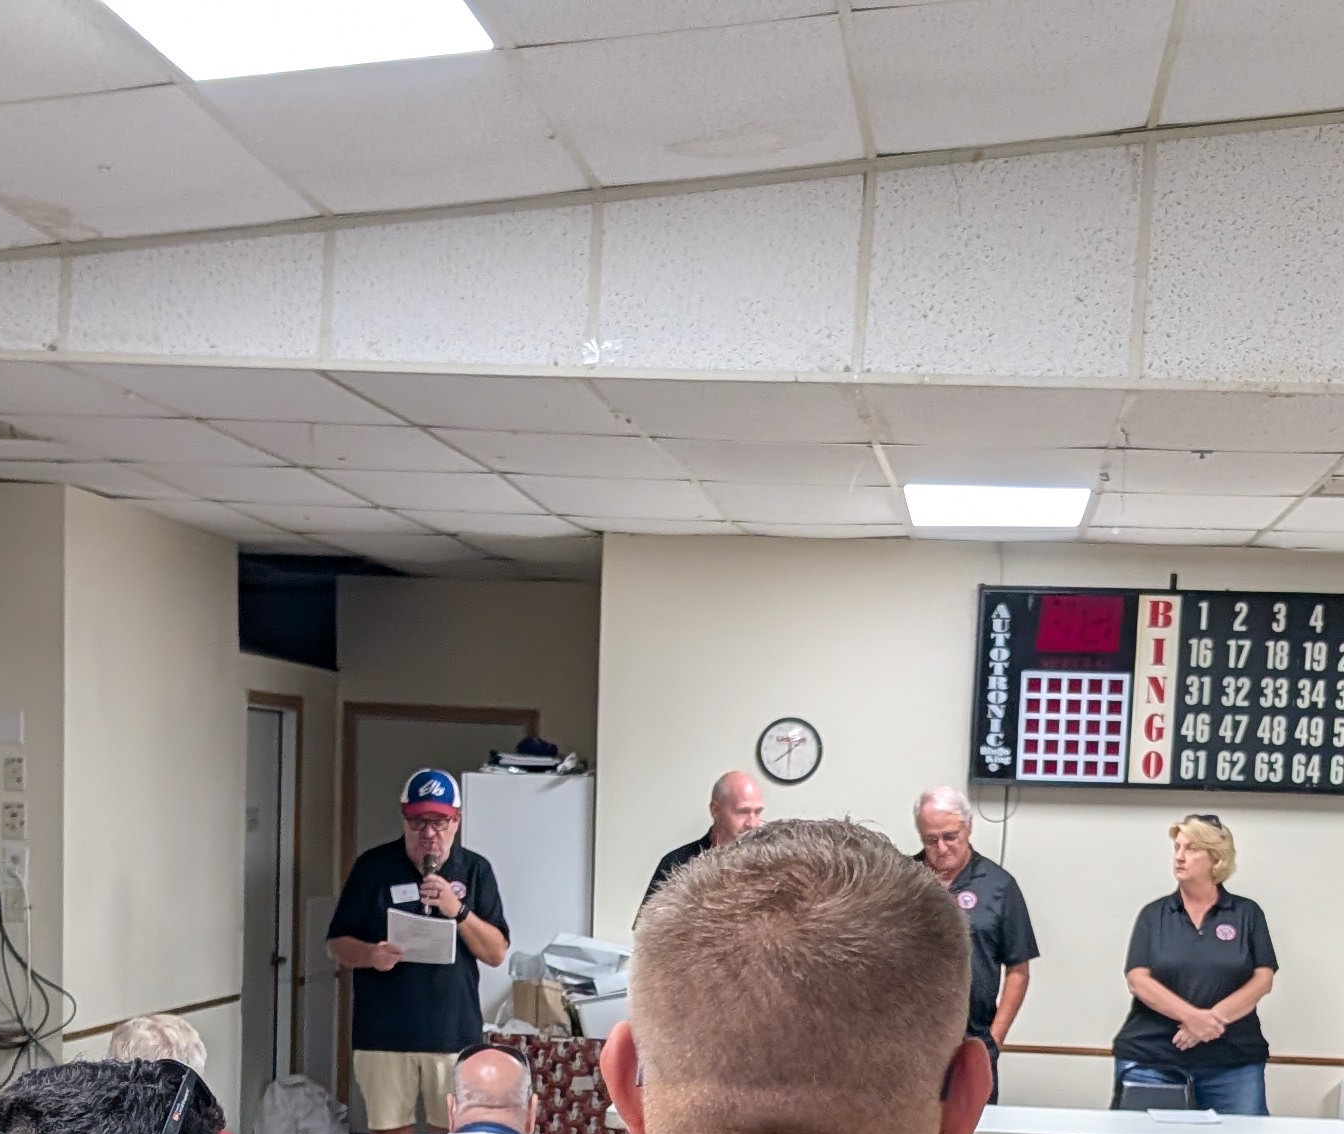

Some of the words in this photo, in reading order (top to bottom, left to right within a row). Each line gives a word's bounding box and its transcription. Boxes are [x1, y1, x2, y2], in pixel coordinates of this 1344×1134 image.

[1198, 601, 1209, 631] 1
[1232, 602, 1249, 632] 2
[1271, 602, 1287, 633] 3
[1309, 604, 1324, 634] 4
[1188, 638, 1213, 669] 16
[1226, 639, 1252, 669] 17
[1264, 640, 1290, 671] 18
[1302, 641, 1328, 672] 19
[986, 603, 1011, 746] AUTOTRONIC
[1142, 600, 1173, 779] BINGO
[1184, 675, 1212, 706] 31
[1220, 676, 1252, 707] 32
[1259, 677, 1289, 708] 33
[1296, 678, 1326, 709] 34
[1180, 712, 1211, 744] 46
[1218, 714, 1250, 744] 47
[1256, 715, 1287, 746] 48
[1294, 716, 1325, 747] 49
[1179, 749, 1208, 780] 61
[1216, 750, 1247, 782] 62
[1254, 751, 1284, 783] 63
[1291, 752, 1321, 784] 64
